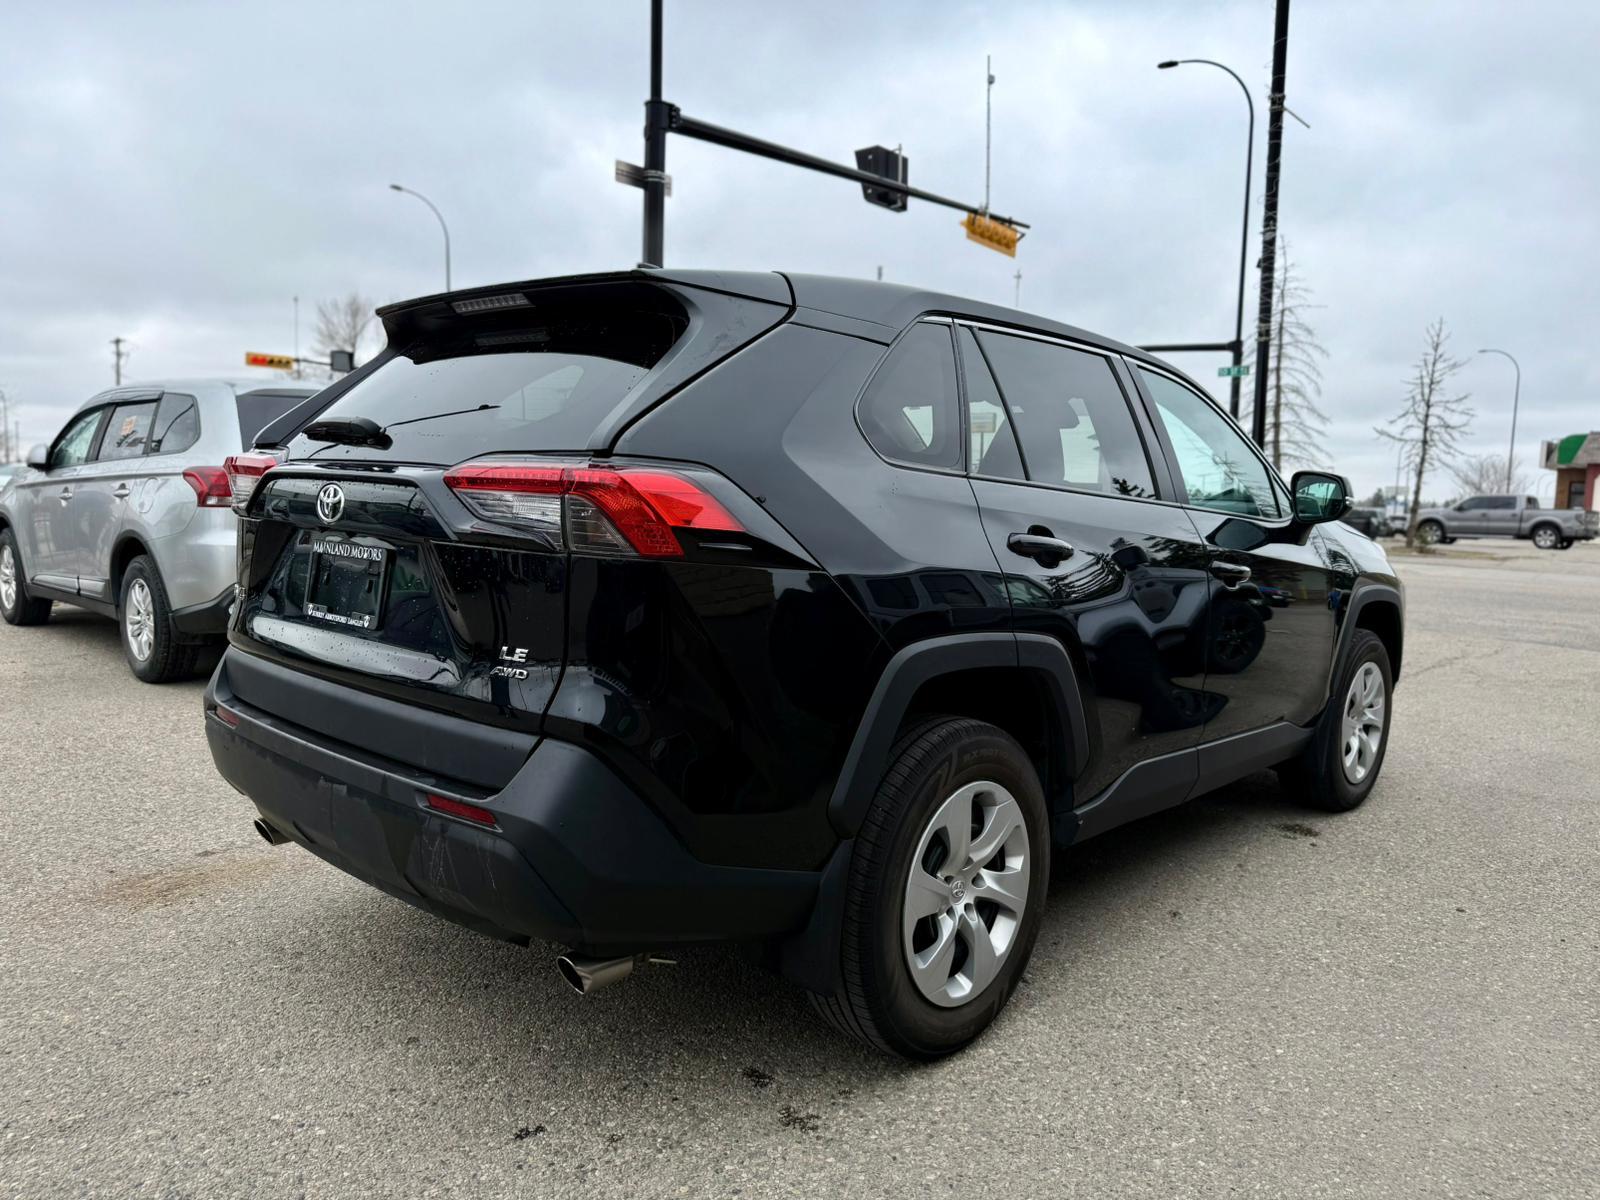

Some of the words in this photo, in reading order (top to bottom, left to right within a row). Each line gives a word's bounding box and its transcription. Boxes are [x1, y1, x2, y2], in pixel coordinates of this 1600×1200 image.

[313, 541, 350, 557] MAINLAND
[351, 545, 383, 561] MOTORS
[499, 646, 529, 663] LE
[490, 666, 528, 679] AWD
